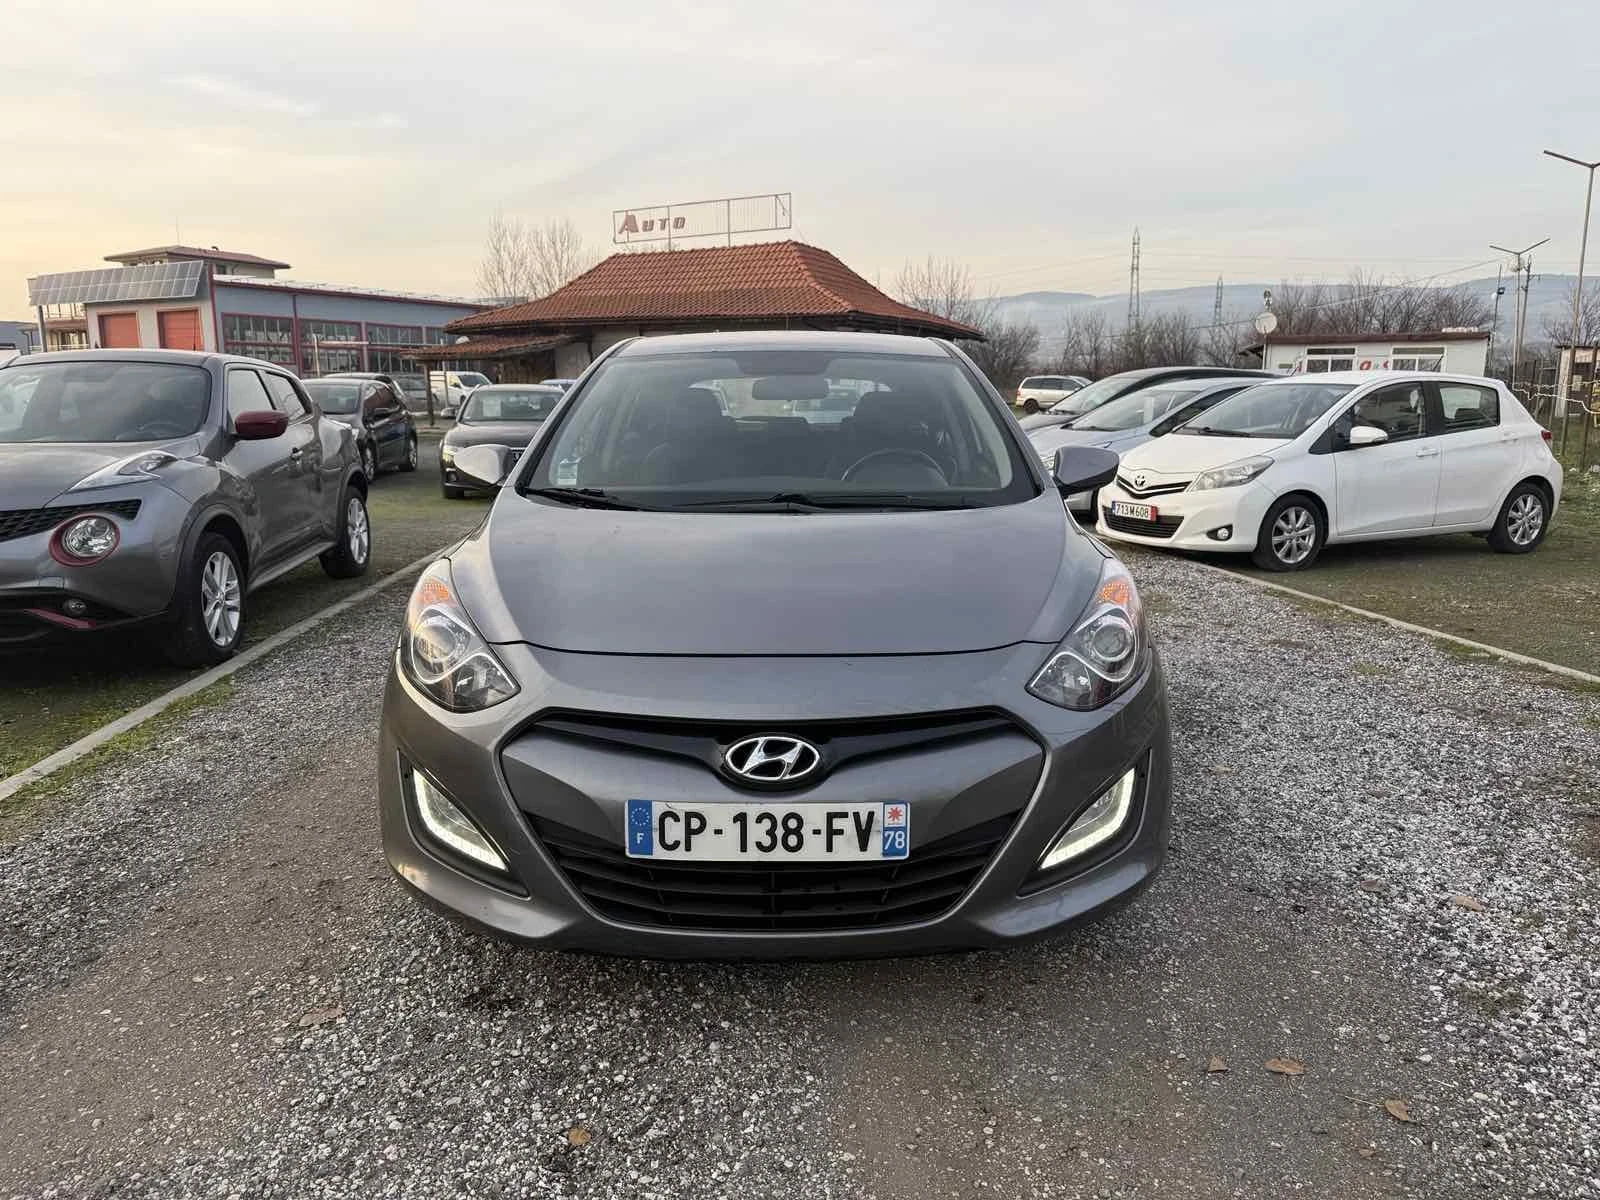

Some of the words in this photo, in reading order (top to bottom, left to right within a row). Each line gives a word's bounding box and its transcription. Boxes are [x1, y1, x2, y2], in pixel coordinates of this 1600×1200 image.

[1116, 504, 1149, 518] 713M608
[636, 832, 645, 844] F
[658, 810, 875, 853] CP-138-FV
[884, 830, 905, 850] 78
